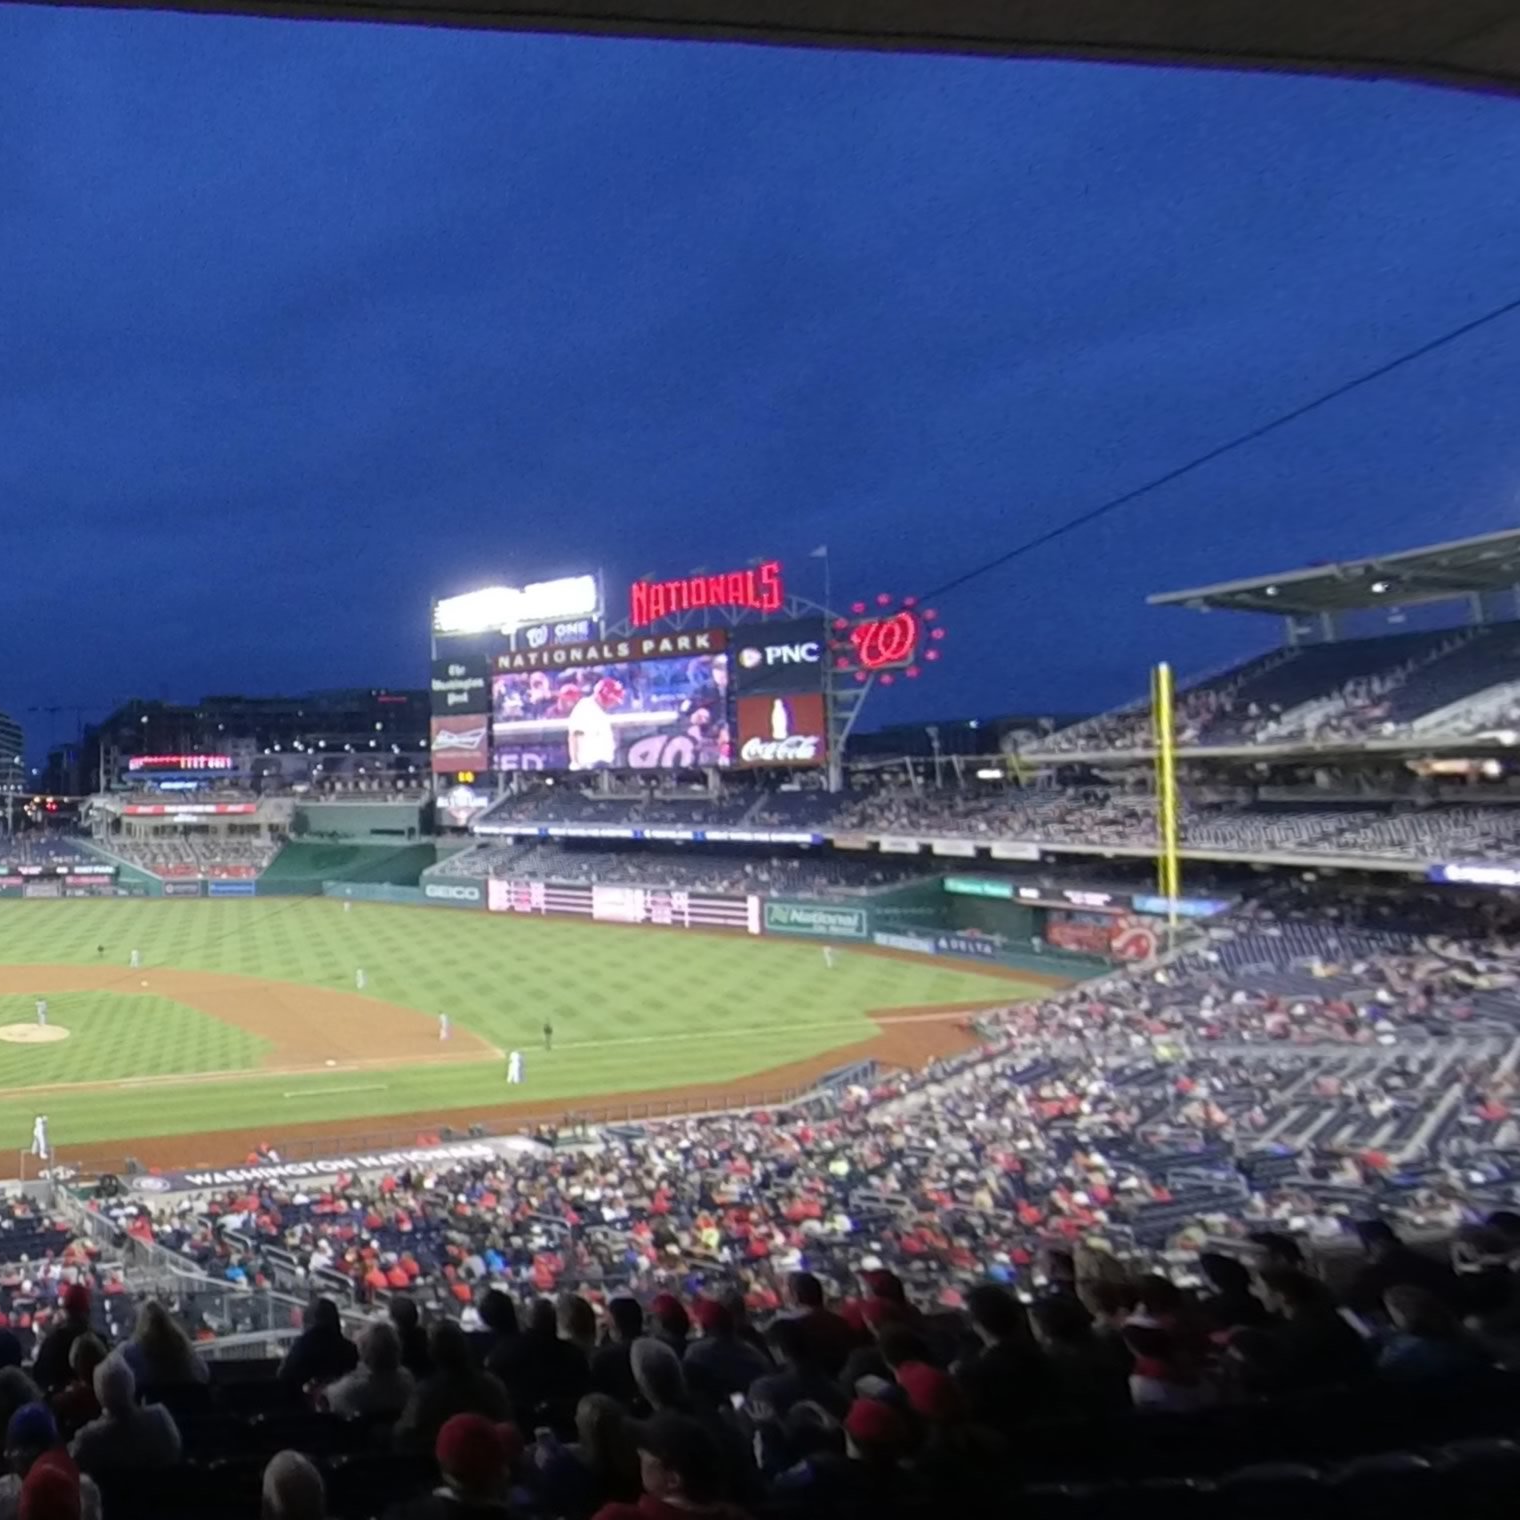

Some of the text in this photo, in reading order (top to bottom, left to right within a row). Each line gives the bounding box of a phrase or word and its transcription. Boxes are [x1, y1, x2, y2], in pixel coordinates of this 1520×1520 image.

[497, 633, 711, 669] NATIONALS PARK
[765, 642, 820, 665] PNC
[425, 884, 480, 900] GEICO
[789, 909, 859, 928] National
[950, 940, 993, 955] DELTA
[185, 1144, 496, 1187] WASHINGTON NATIONALS
